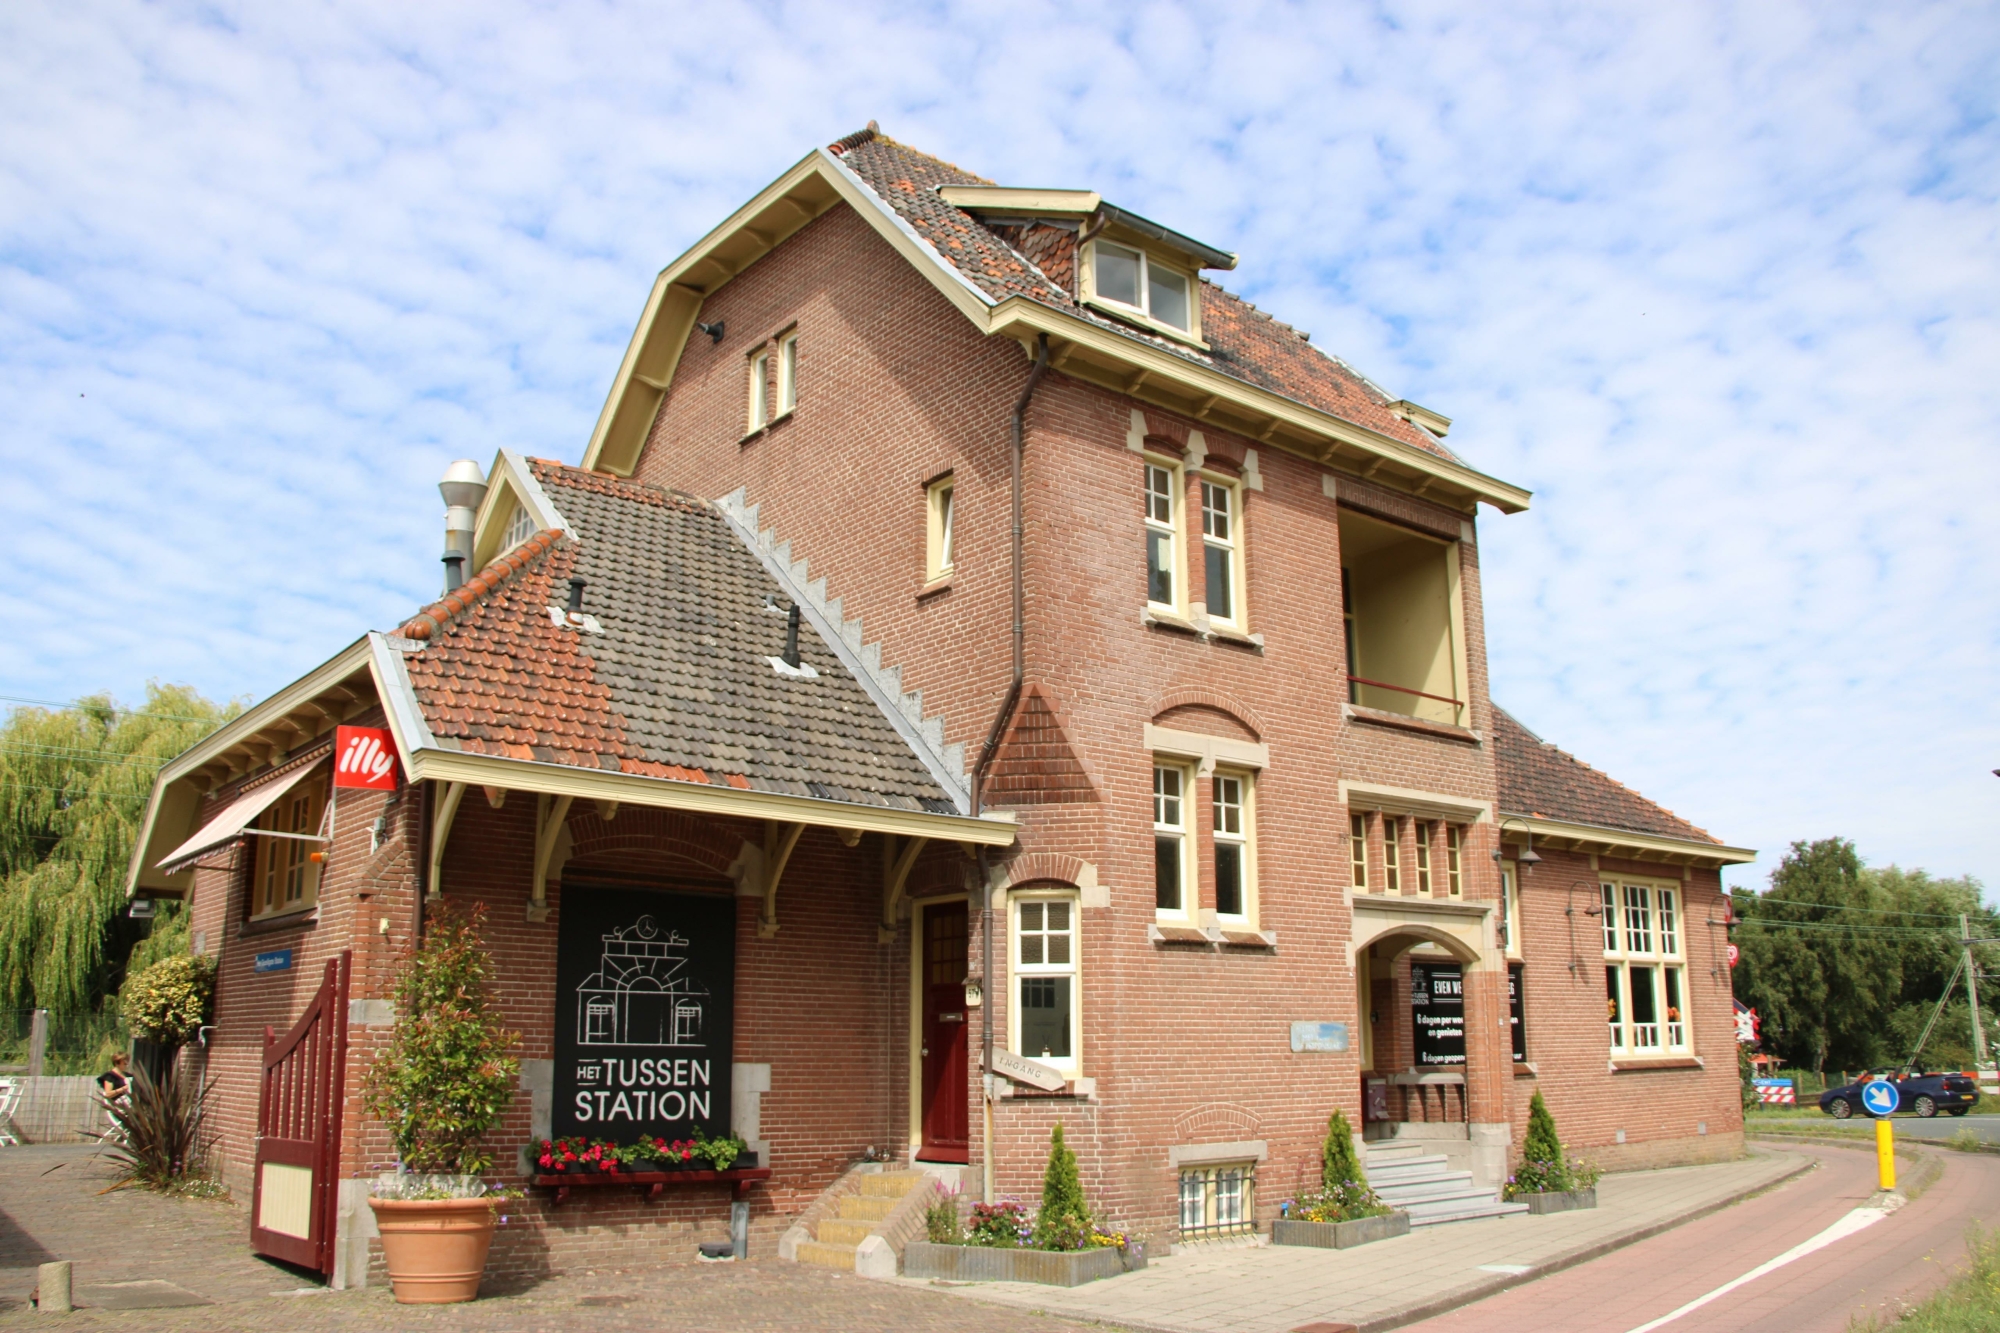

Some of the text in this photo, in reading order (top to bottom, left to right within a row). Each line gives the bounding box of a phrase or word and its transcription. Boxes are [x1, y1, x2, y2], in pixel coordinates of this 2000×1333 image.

[339, 736, 394, 783] illy
[1434, 981, 1451, 994] EVEN
[1417, 1013, 1422, 1024] 6
[1422, 1015, 1440, 1026] dagen
[1441, 1016, 1452, 1026] per
[1428, 1027, 1462, 1038] en genieten
[1000, 1056, 1041, 1079] INGANG
[1428, 1054, 1444, 1064] dagen
[577, 1058, 710, 1087] HET TUSSEN
[575, 1090, 710, 1121] STATION
